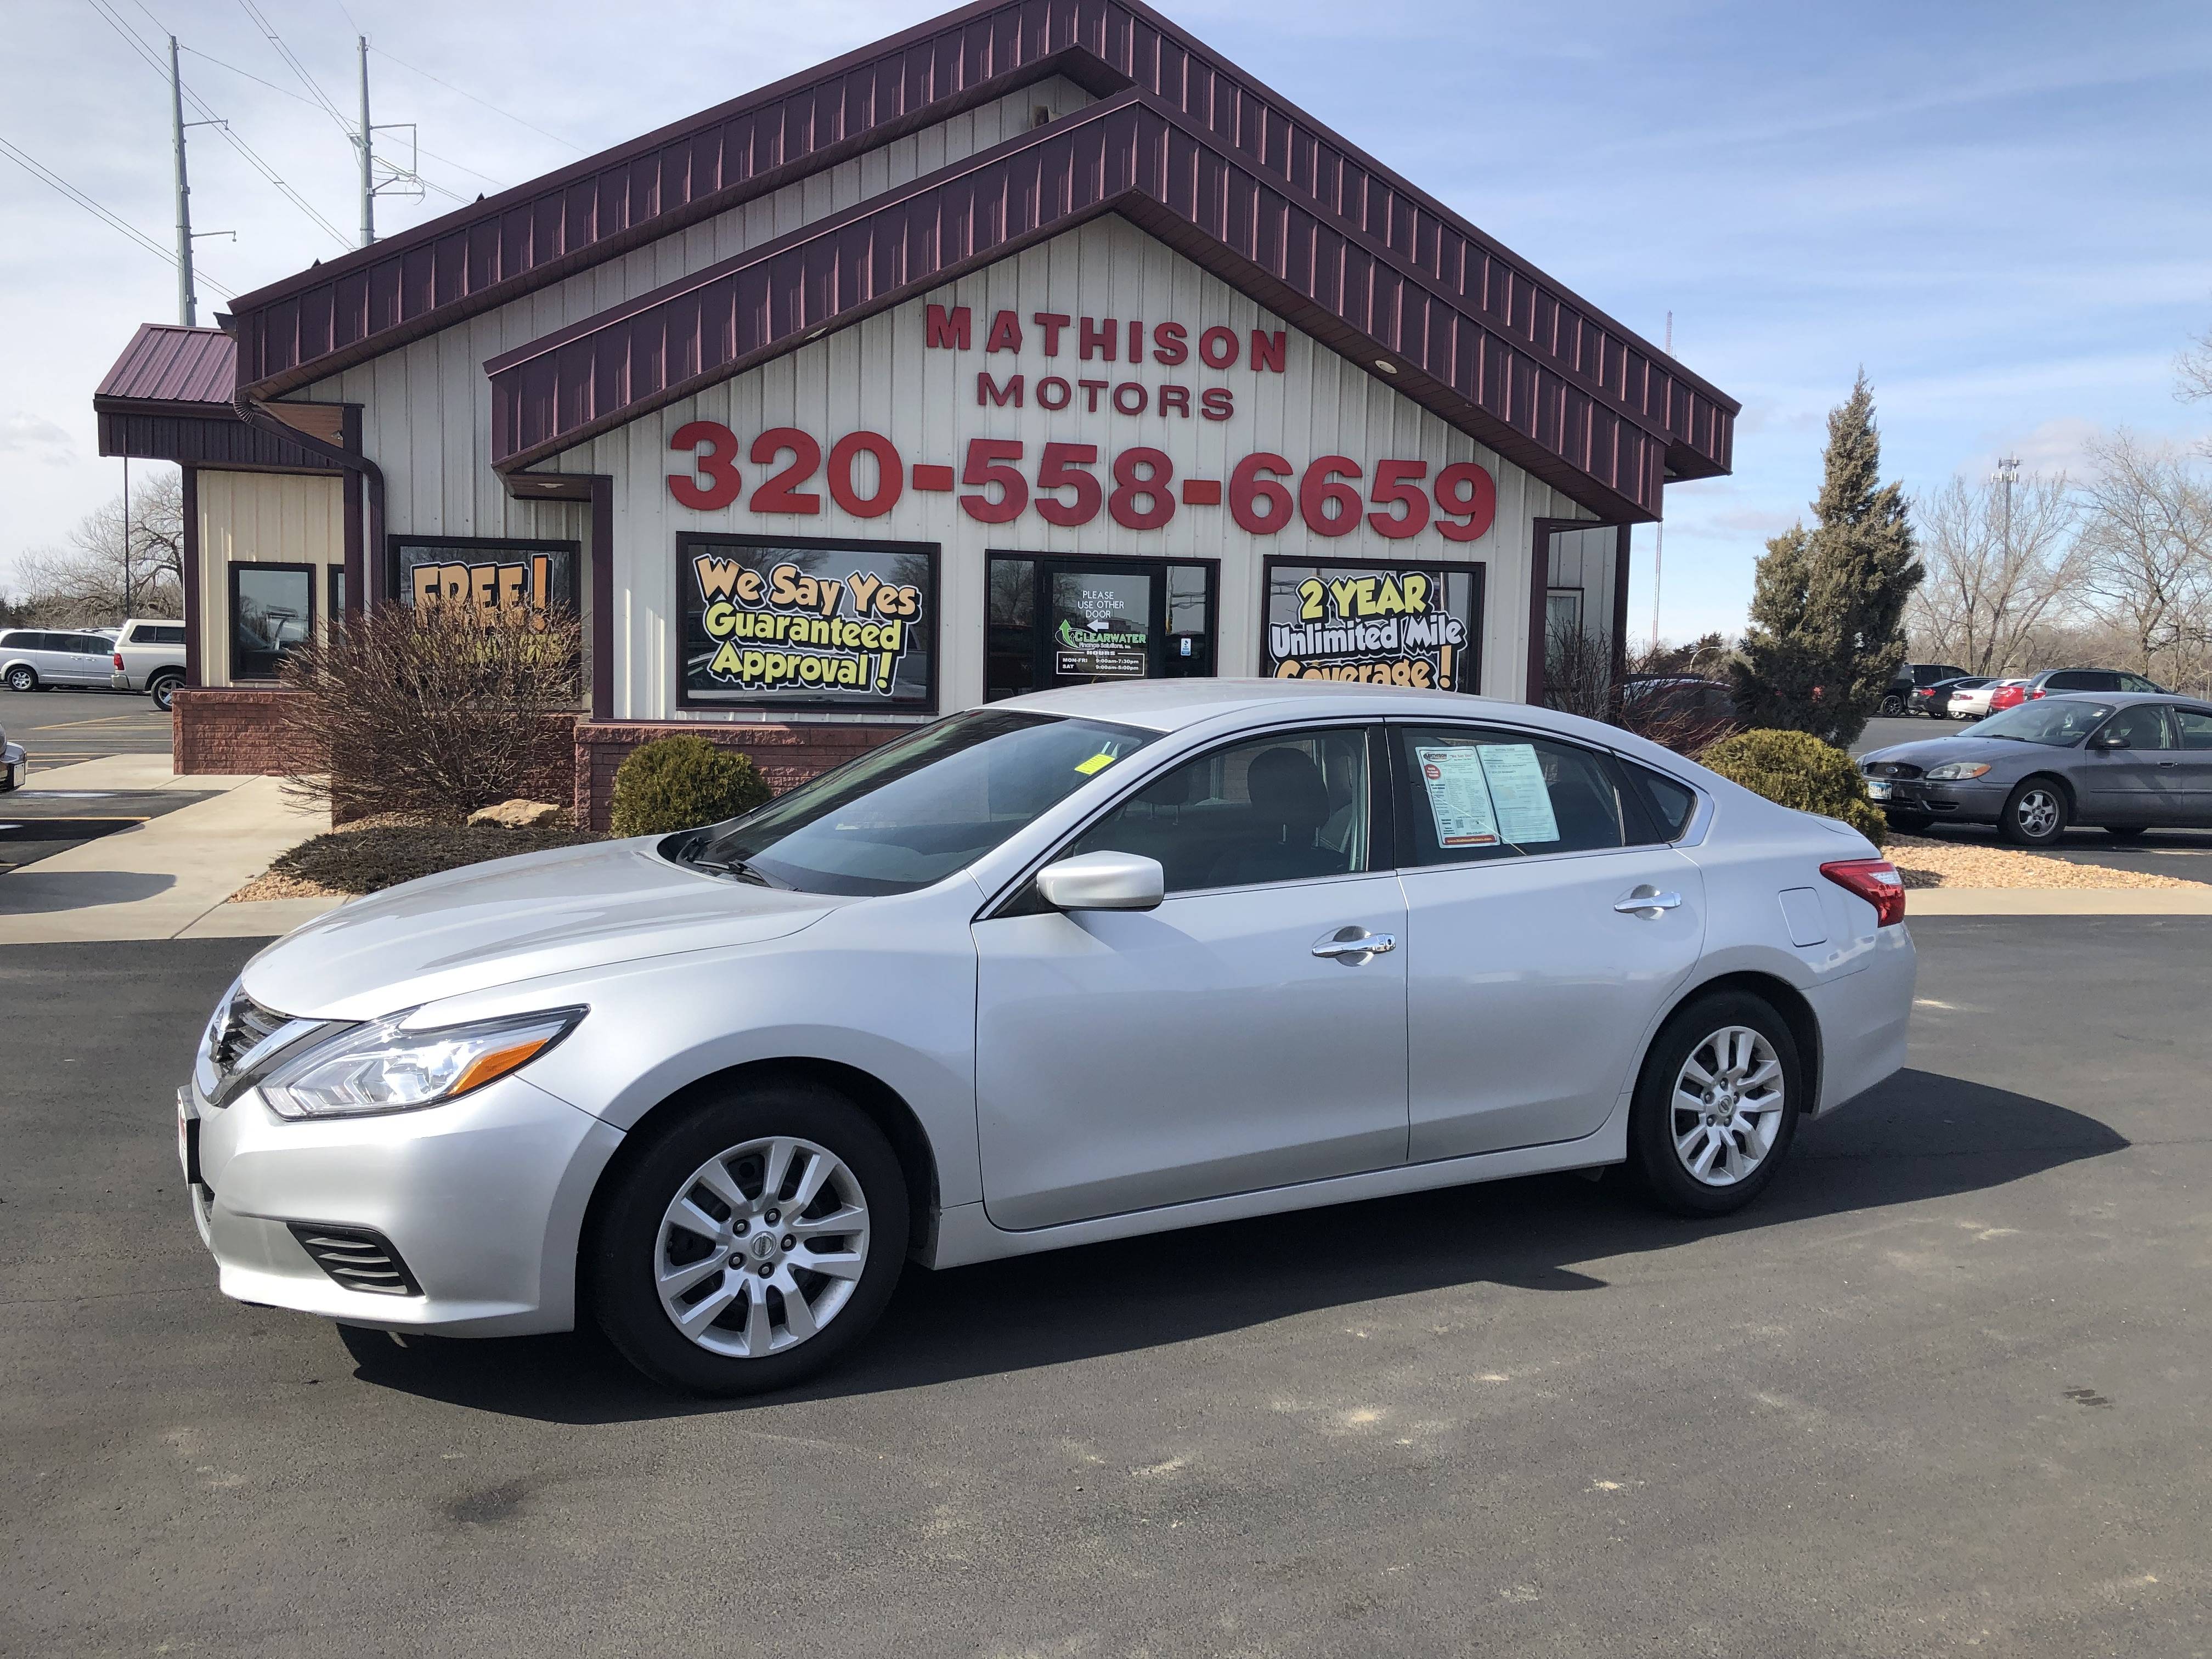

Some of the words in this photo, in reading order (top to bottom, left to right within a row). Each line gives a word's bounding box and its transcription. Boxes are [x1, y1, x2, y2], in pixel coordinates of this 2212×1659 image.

[927, 304, 1286, 373] MATHISON
[978, 372, 1234, 421] MOTORS
[668, 421, 1496, 542] 320-558-6659
[695, 555, 762, 601] We
[770, 565, 843, 616] Say
[848, 572, 917, 616] Yes
[1077, 601, 1093, 609] USE
[1097, 601, 1124, 609] OTHER
[1082, 590, 1114, 600] PLEASE
[1299, 579, 1324, 620] 2
[1329, 574, 1427, 618] YEAR
[706, 602, 902, 651] Guaranteed
[1086, 610, 1111, 618] DOOR
[1271, 614, 1398, 657] Unlimited
[1405, 614, 1462, 647] Mile
[1075, 631, 1147, 644] CLEARWATER
